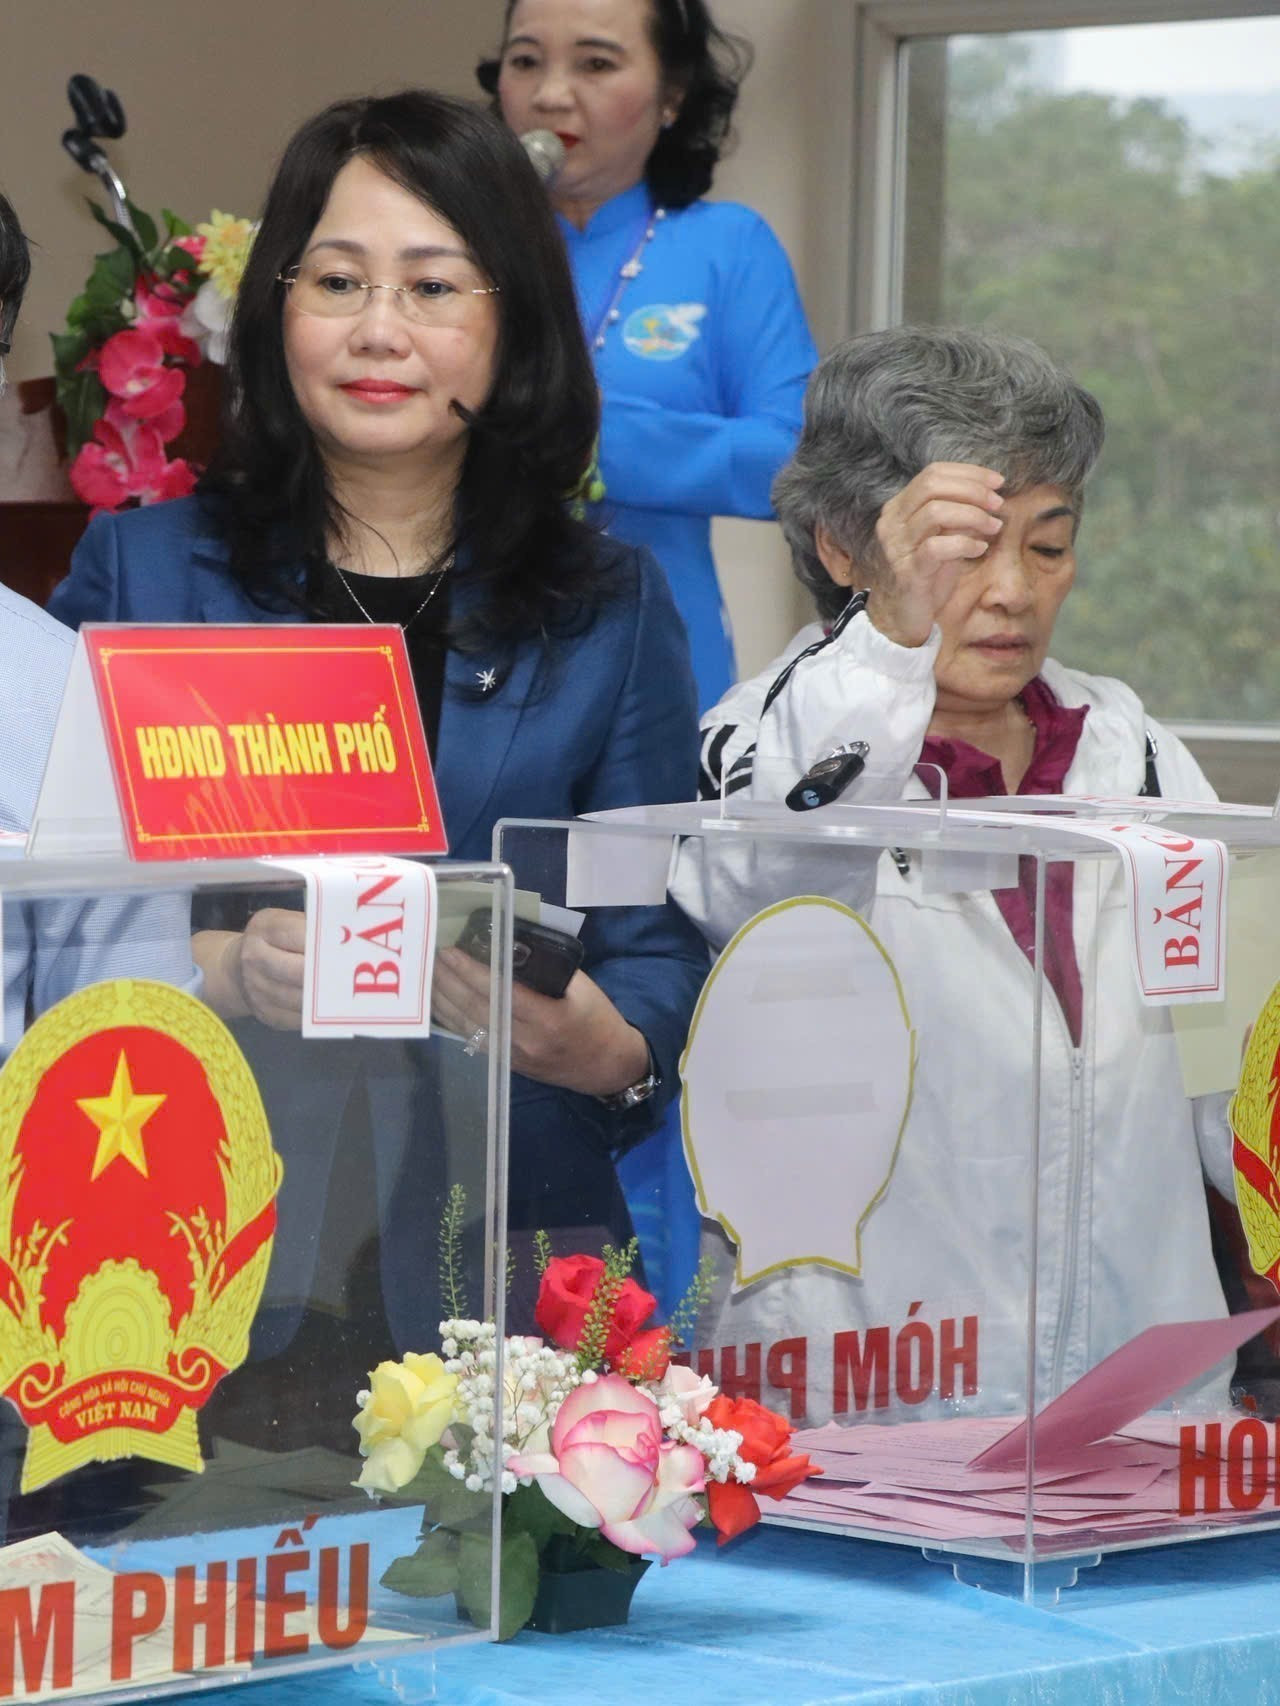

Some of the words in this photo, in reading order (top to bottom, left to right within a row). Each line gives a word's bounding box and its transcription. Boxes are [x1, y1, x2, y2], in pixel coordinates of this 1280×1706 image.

[136, 726, 225, 779] HĐND
[228, 713, 332, 776] THÀNH
[333, 704, 396, 773] PHỐ
[75, 1400, 116, 1429] VIỆT
[119, 1400, 158, 1422] NAM
[1178, 1395, 1280, 1517] HÒ
[110, 1514, 370, 1681] PHIẾU
